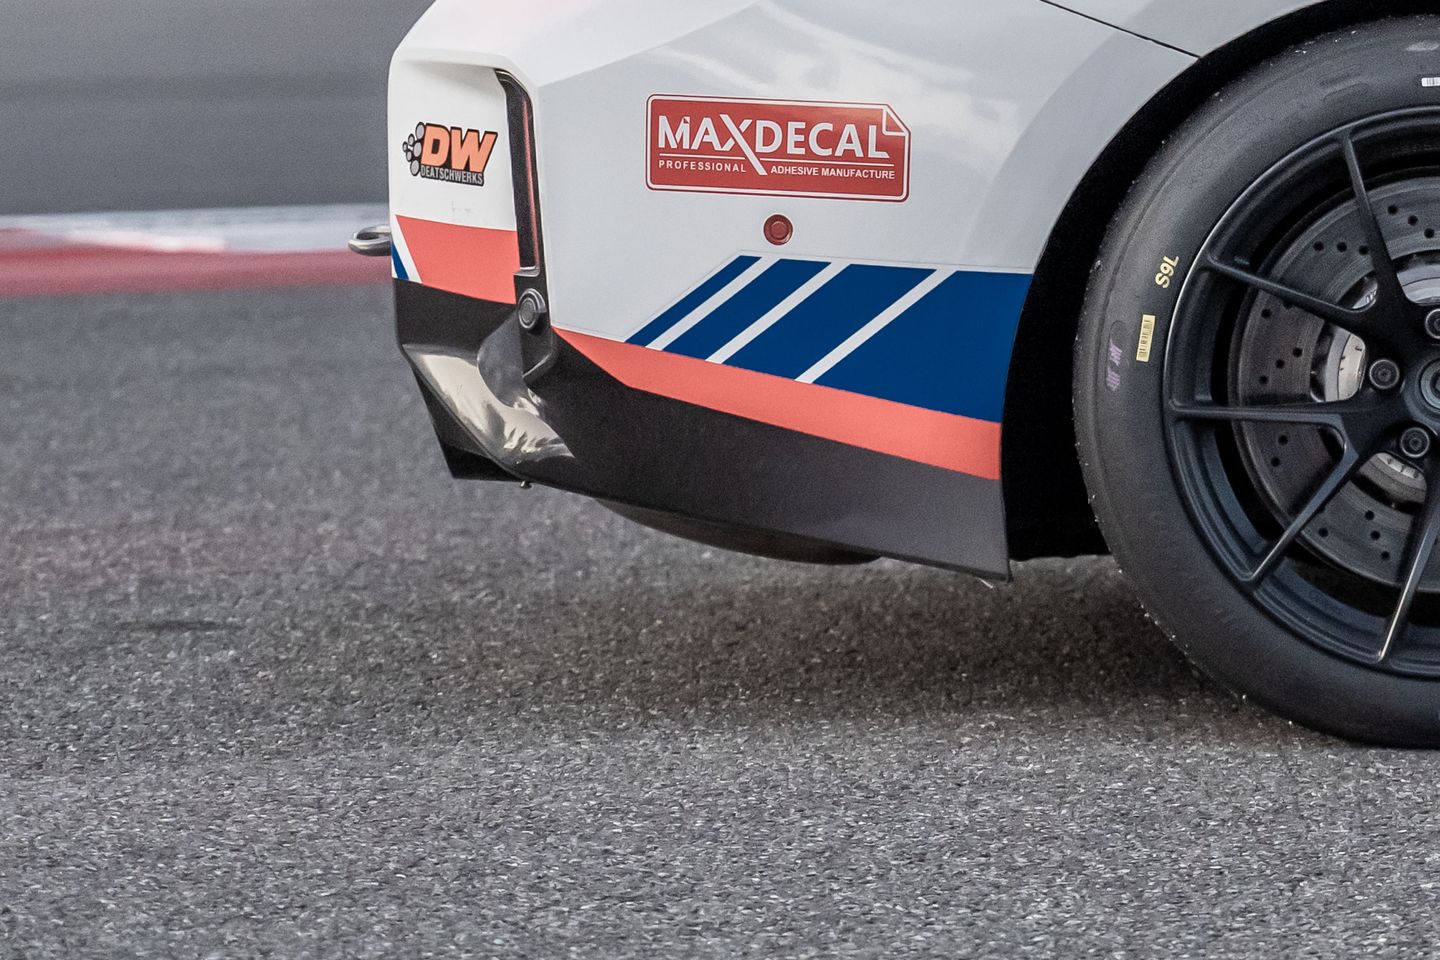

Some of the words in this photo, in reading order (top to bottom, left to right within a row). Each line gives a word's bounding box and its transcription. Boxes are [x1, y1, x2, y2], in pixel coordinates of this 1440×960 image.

[420, 123, 498, 173] DW
[658, 113, 890, 175] MAXDECAL
[420, 165, 484, 185] DEATSCHWERKS
[658, 160, 746, 173] PROFESSIONAL
[770, 165, 819, 177] ADHESIVE
[821, 167, 895, 180] MANUFACTURE
[1155, 255, 1180, 289] 76S
